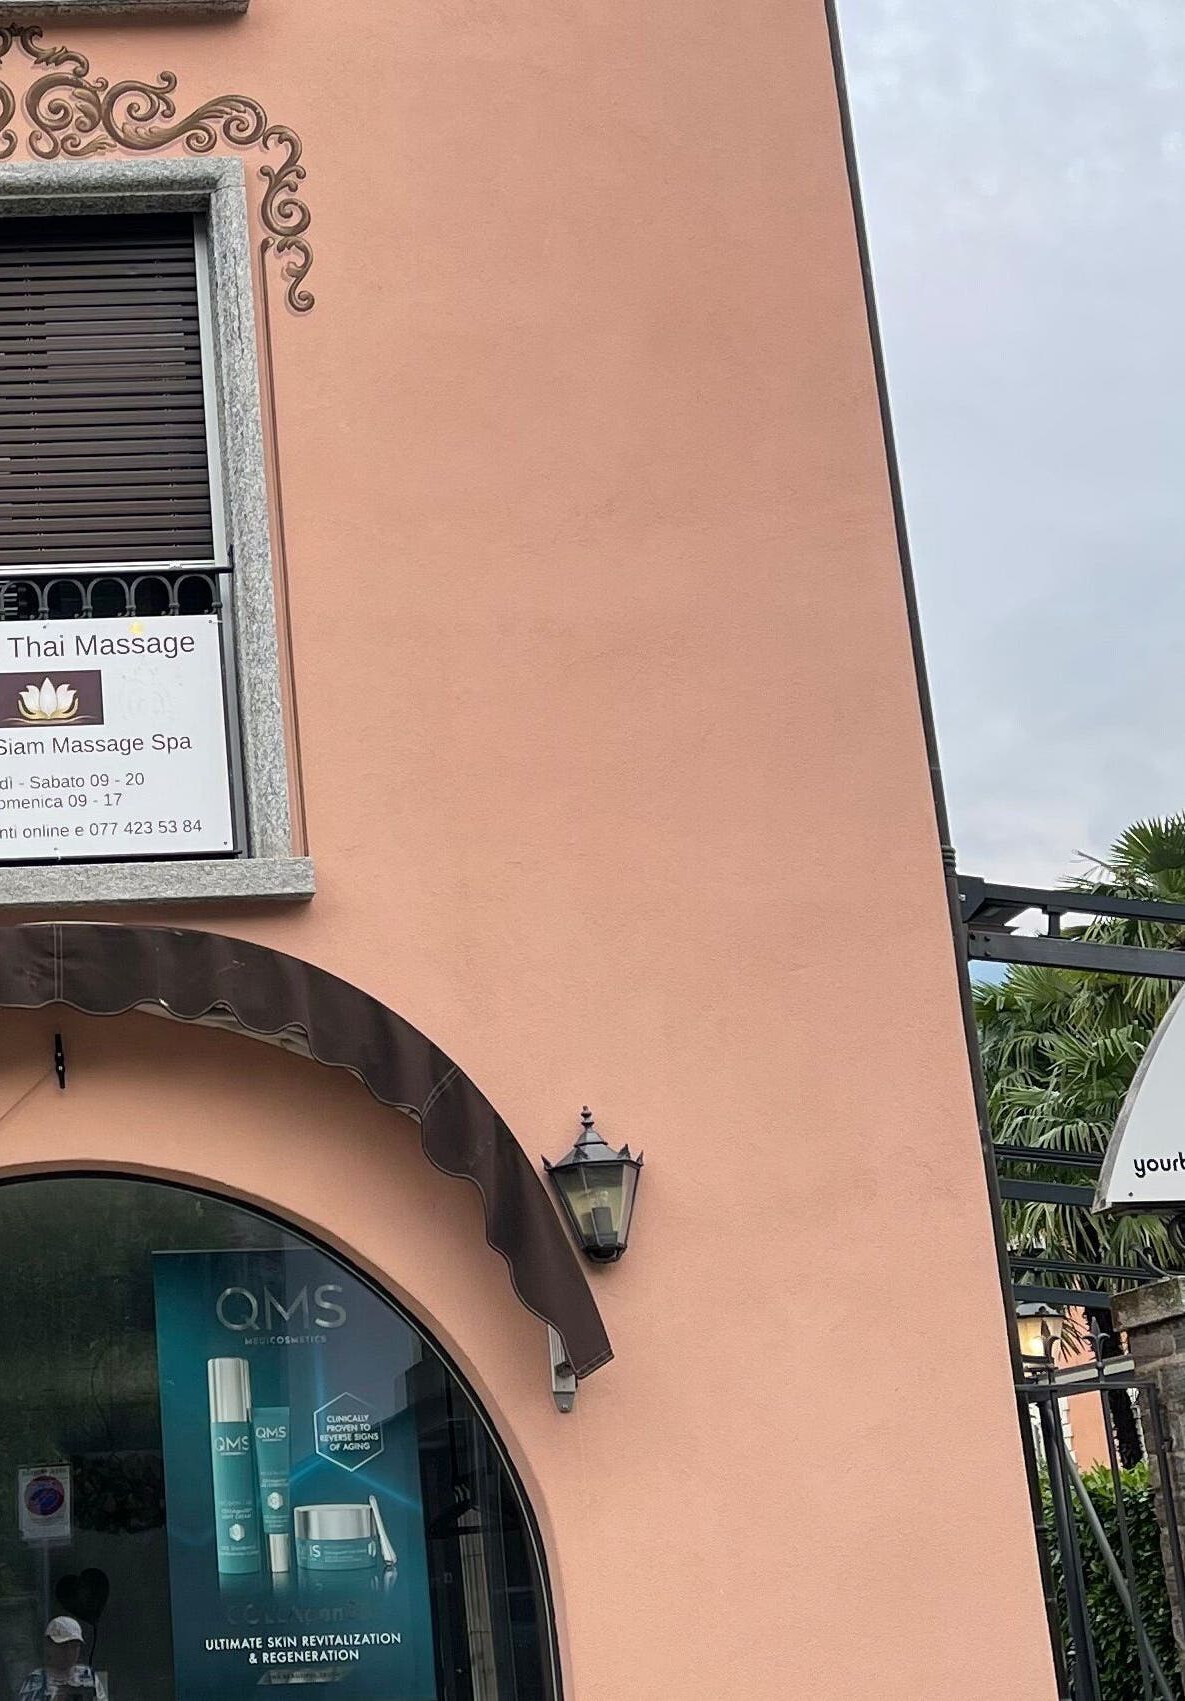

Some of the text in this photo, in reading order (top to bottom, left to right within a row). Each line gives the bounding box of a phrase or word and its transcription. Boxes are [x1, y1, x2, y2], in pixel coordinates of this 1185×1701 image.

[7, 634, 65, 658] Thai
[75, 633, 195, 659] Massage
[52, 737, 144, 756] Massage
[151, 733, 193, 754] Spa
[29, 774, 85, 790] Sabato
[90, 773, 109, 788] 09
[125, 772, 145, 786] 20
[68, 794, 88, 808] 09
[105, 793, 123, 807] 17
[23, 824, 70, 839] online
[75, 826, 84, 837] e
[89, 823, 117, 837] 077
[123, 821, 153, 835] 423
[158, 820, 178, 834] 53
[182, 819, 202, 833] 84
[216, 1284, 347, 1331] QMS
[326, 1414, 370, 1423] CLINICALLY
[255, 1426, 287, 1439] QMS
[326, 1423, 371, 1433] PROVEN TO
[215, 1435, 250, 1451] QMS
[319, 1432, 379, 1442] REVERSE SIGNS
[329, 1442, 371, 1452] OF AGING
[205, 1632, 401, 1651] ULTIMATE SKIN REVITALIZATION
[248, 1649, 359, 1664] & REGENERATION
